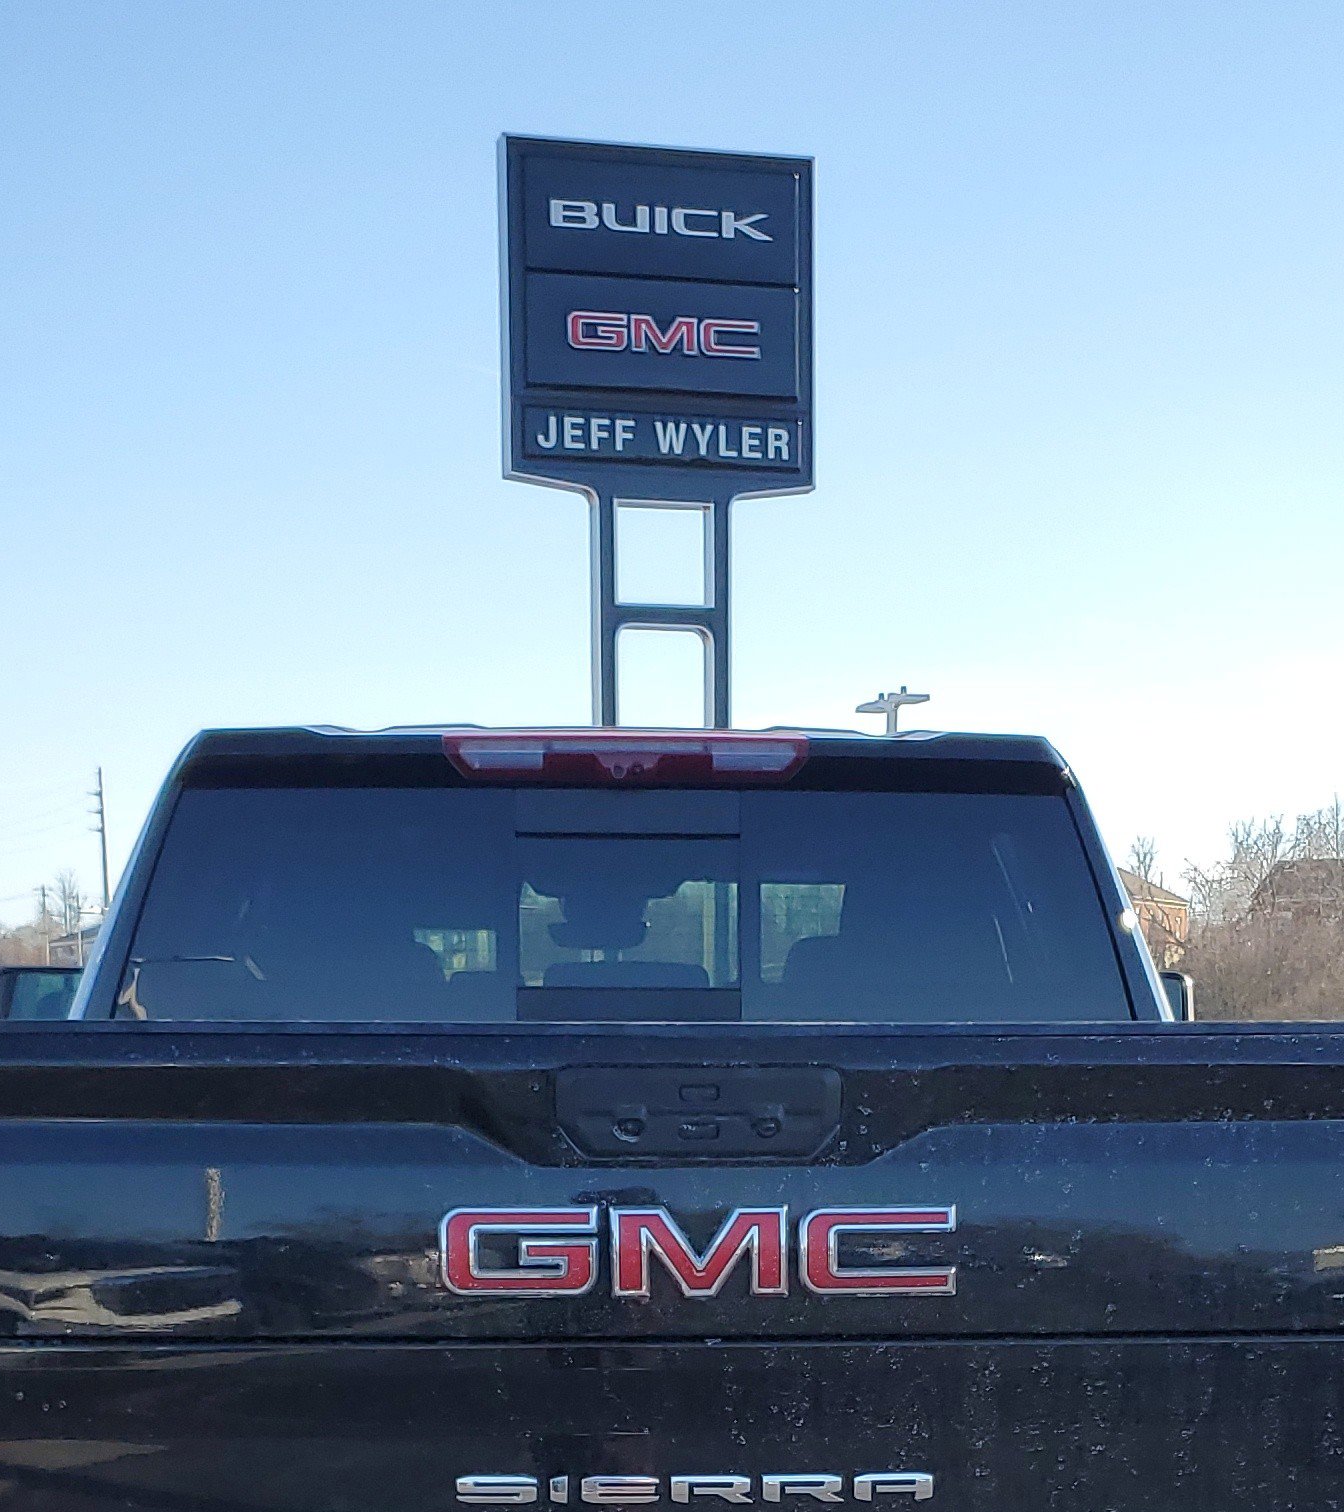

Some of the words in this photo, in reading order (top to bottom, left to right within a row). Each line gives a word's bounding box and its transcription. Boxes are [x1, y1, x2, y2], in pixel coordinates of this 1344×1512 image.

[549, 199, 774, 242] BUICK
[567, 310, 762, 360] GMC
[536, 416, 635, 452] JEFF
[654, 420, 791, 461] WYLER
[439, 1204, 958, 1298] GMC
[454, 1472, 935, 1504] SIERRA
